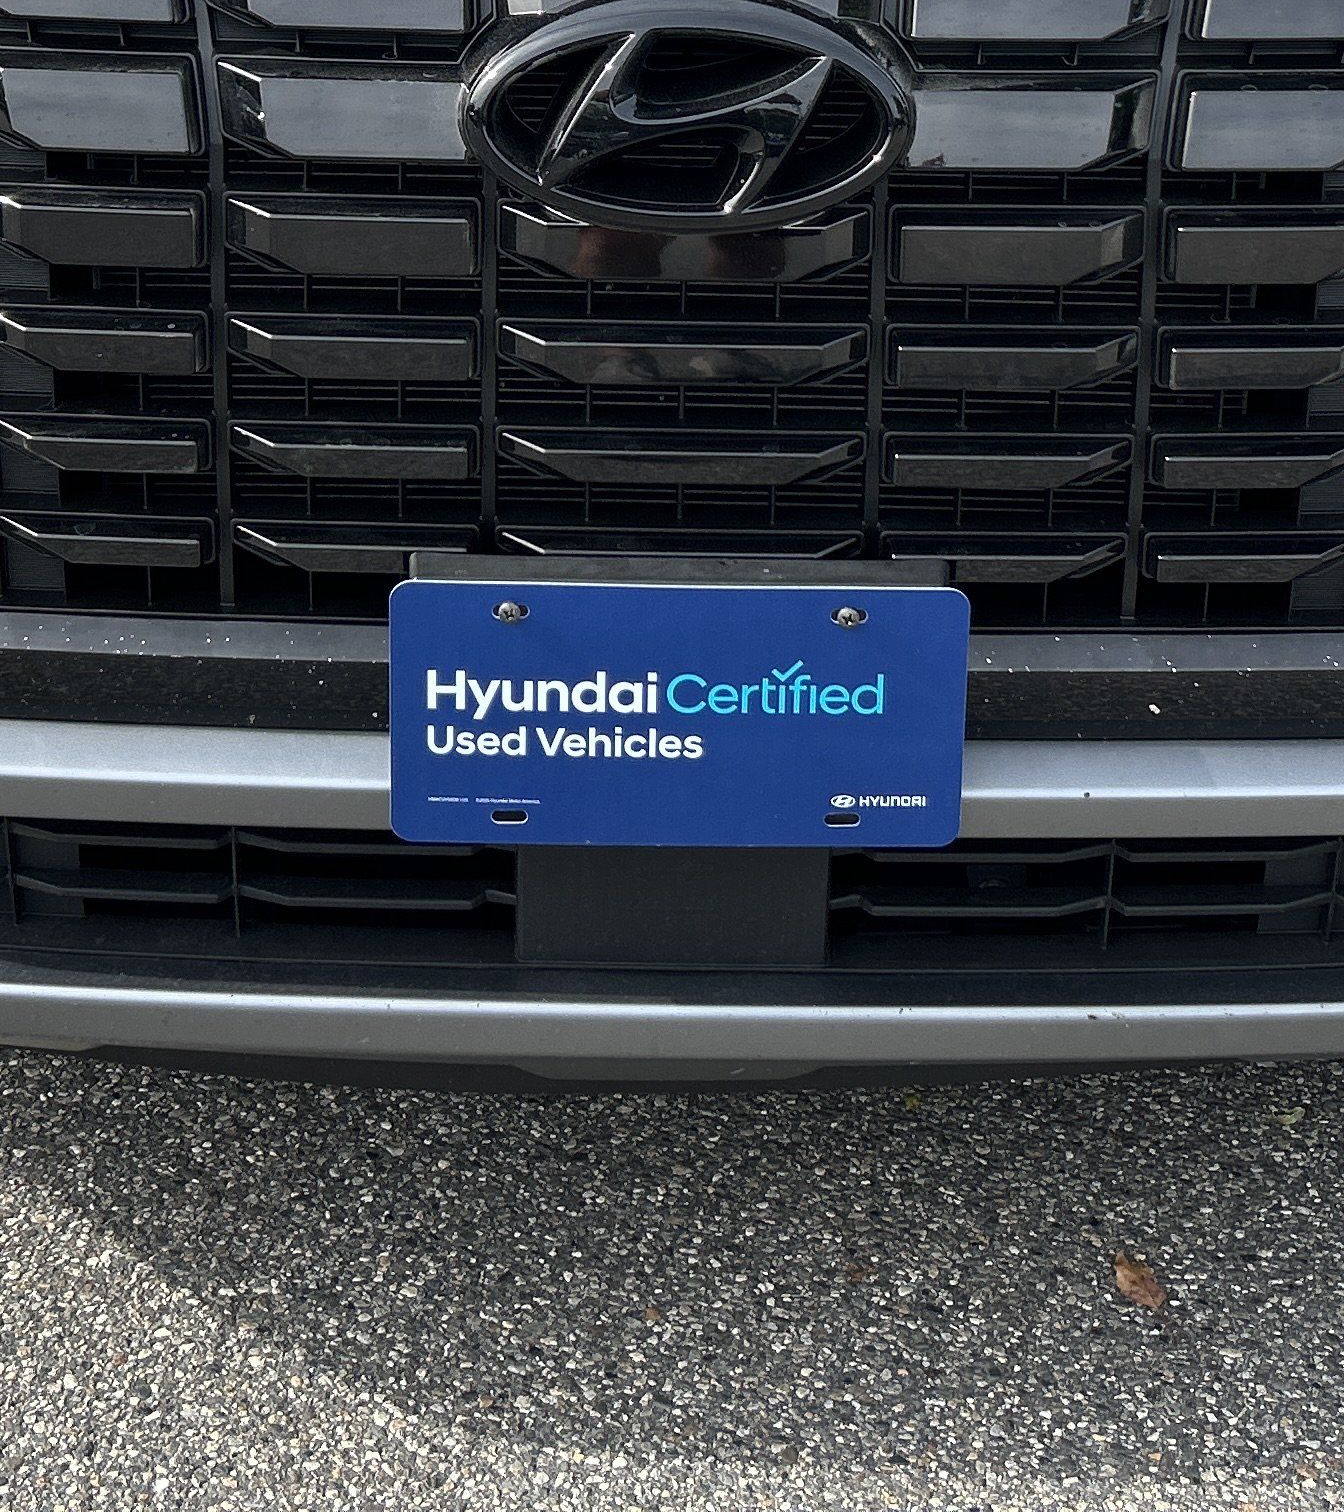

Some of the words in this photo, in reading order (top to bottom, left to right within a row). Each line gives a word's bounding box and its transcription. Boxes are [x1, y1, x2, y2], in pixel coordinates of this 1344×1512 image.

[426, 669, 658, 720] Hyundai
[666, 659, 885, 715] Certified
[426, 724, 527, 757] Used
[536, 726, 704, 759] Vehicles
[858, 795, 927, 807] HYUNDAI
